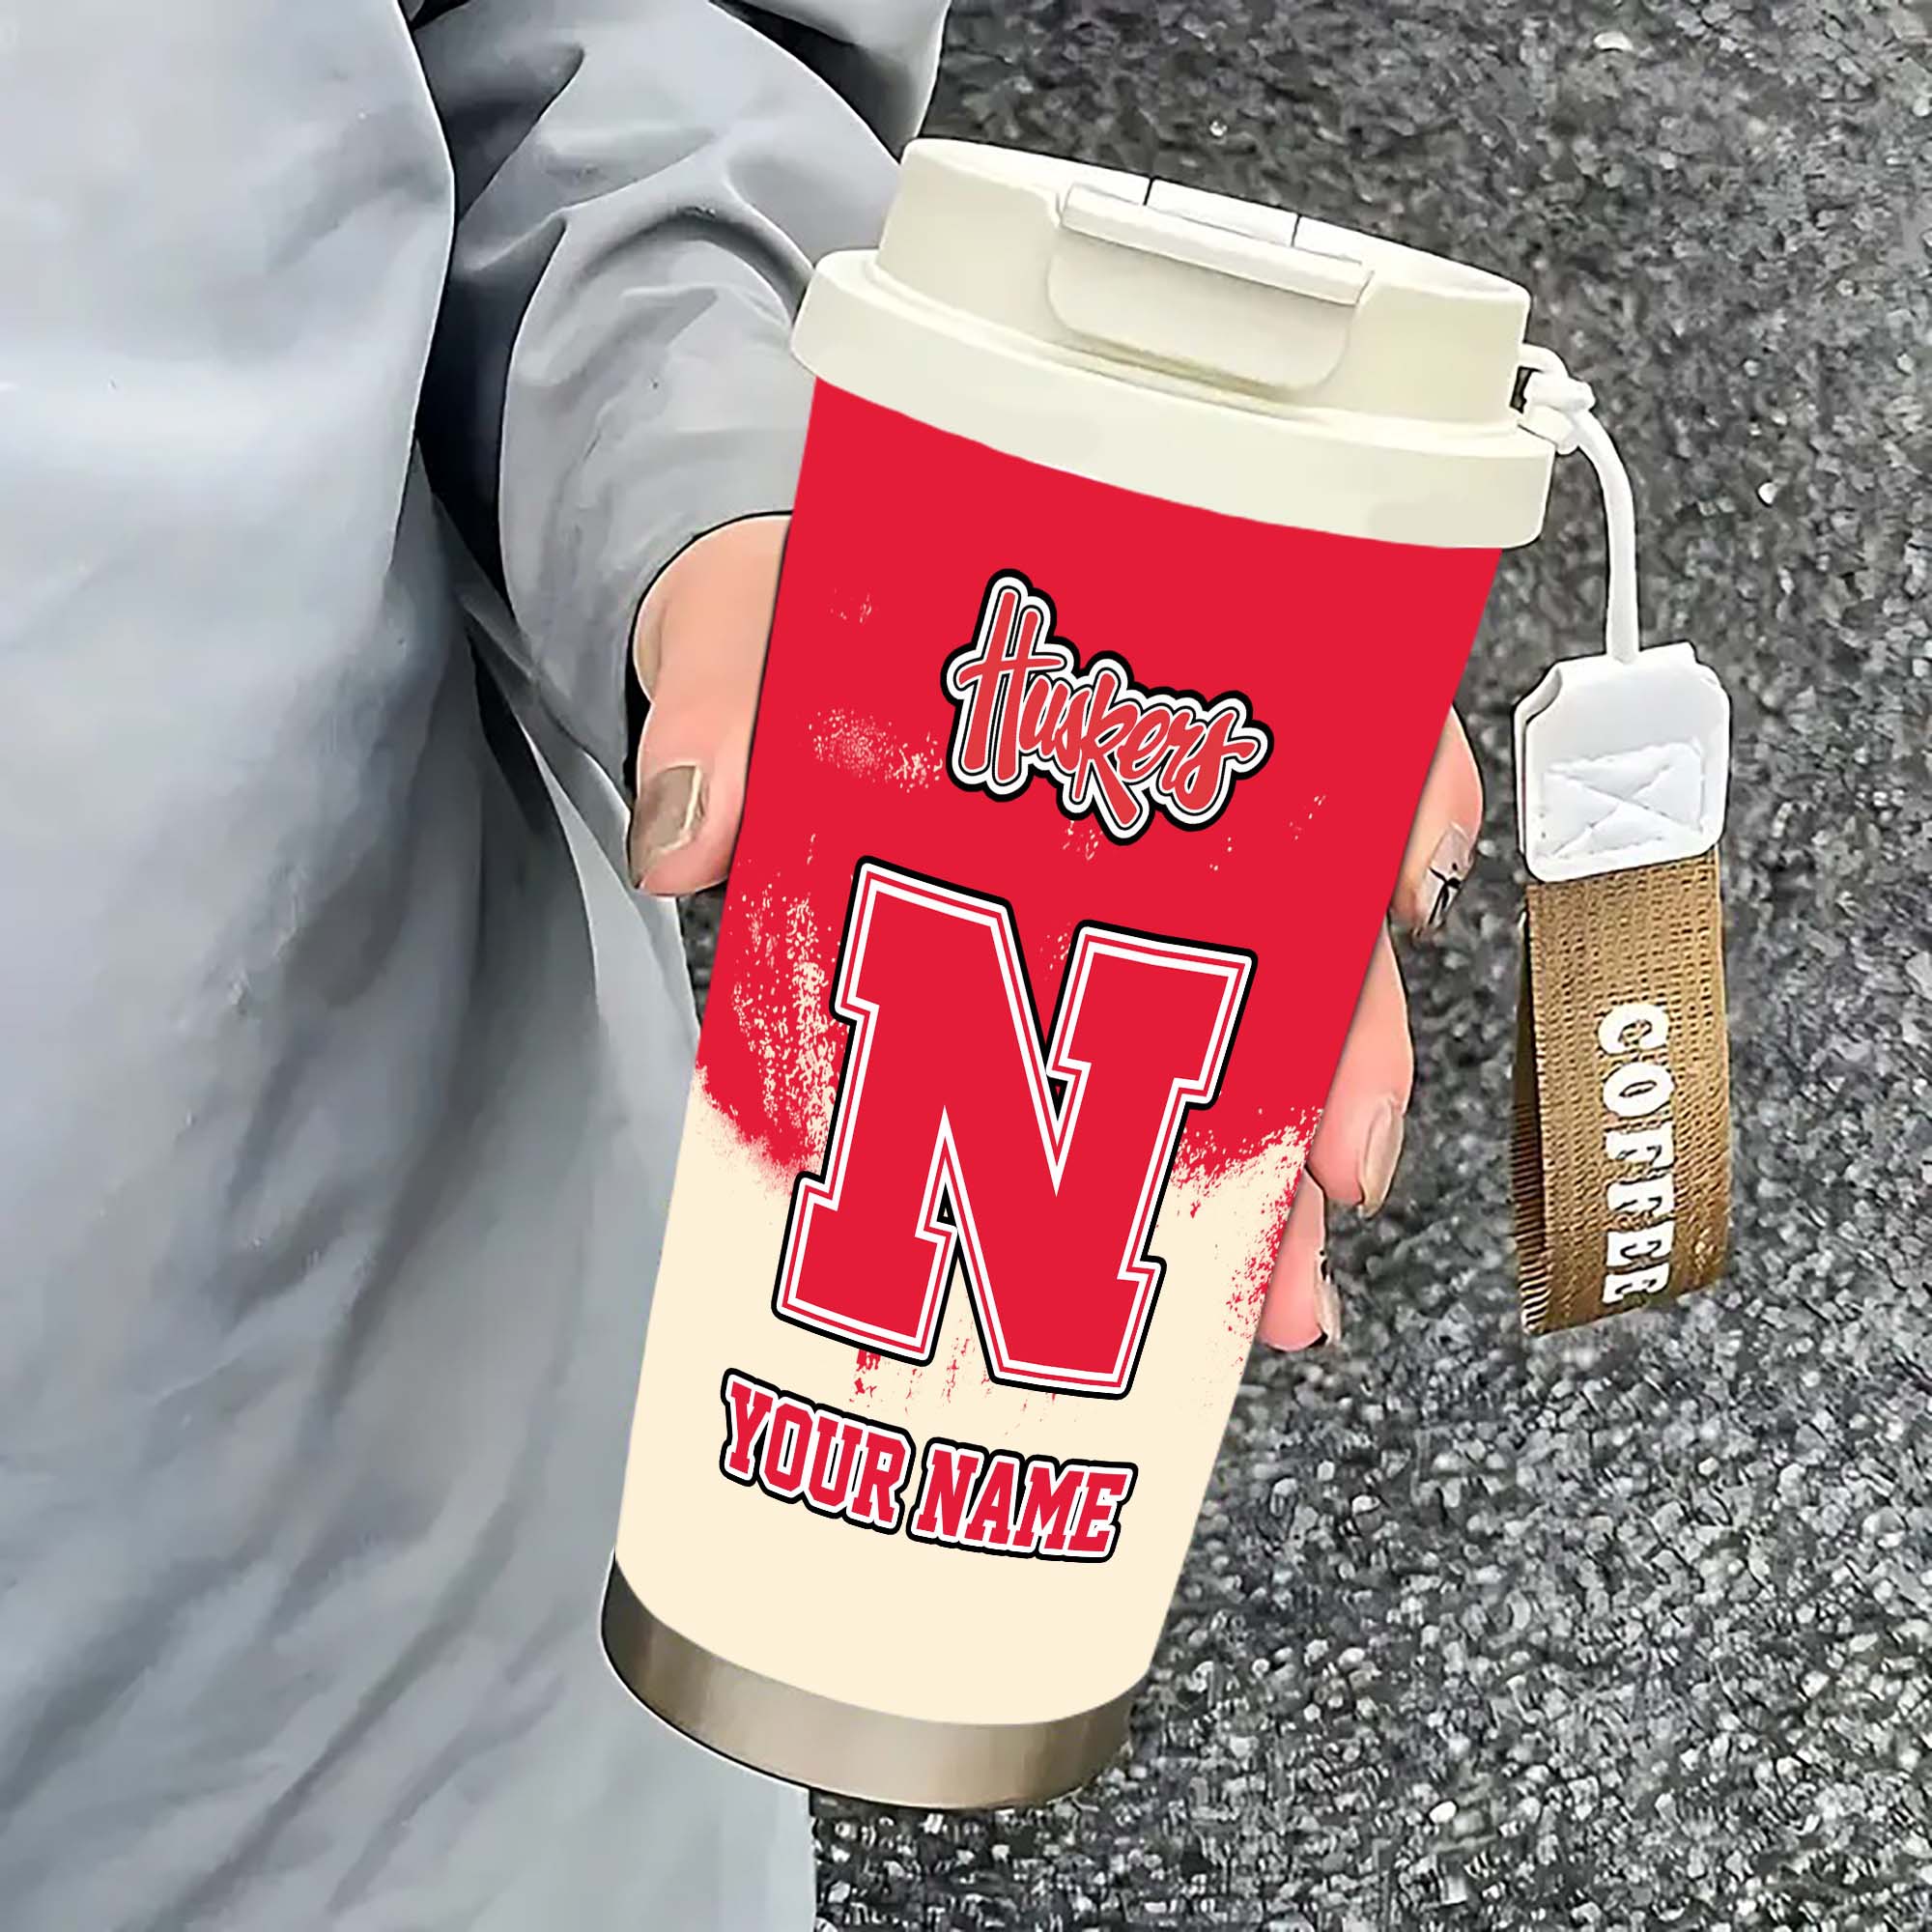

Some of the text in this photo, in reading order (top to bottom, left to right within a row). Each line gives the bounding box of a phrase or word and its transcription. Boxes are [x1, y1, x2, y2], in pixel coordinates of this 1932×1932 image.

[942, 569, 1274, 845] Huskers
[772, 857, 1257, 1399] N
[1597, 1003, 1676, 1305] COFFEE
[720, 1368, 1138, 1563] YOUR NAME
